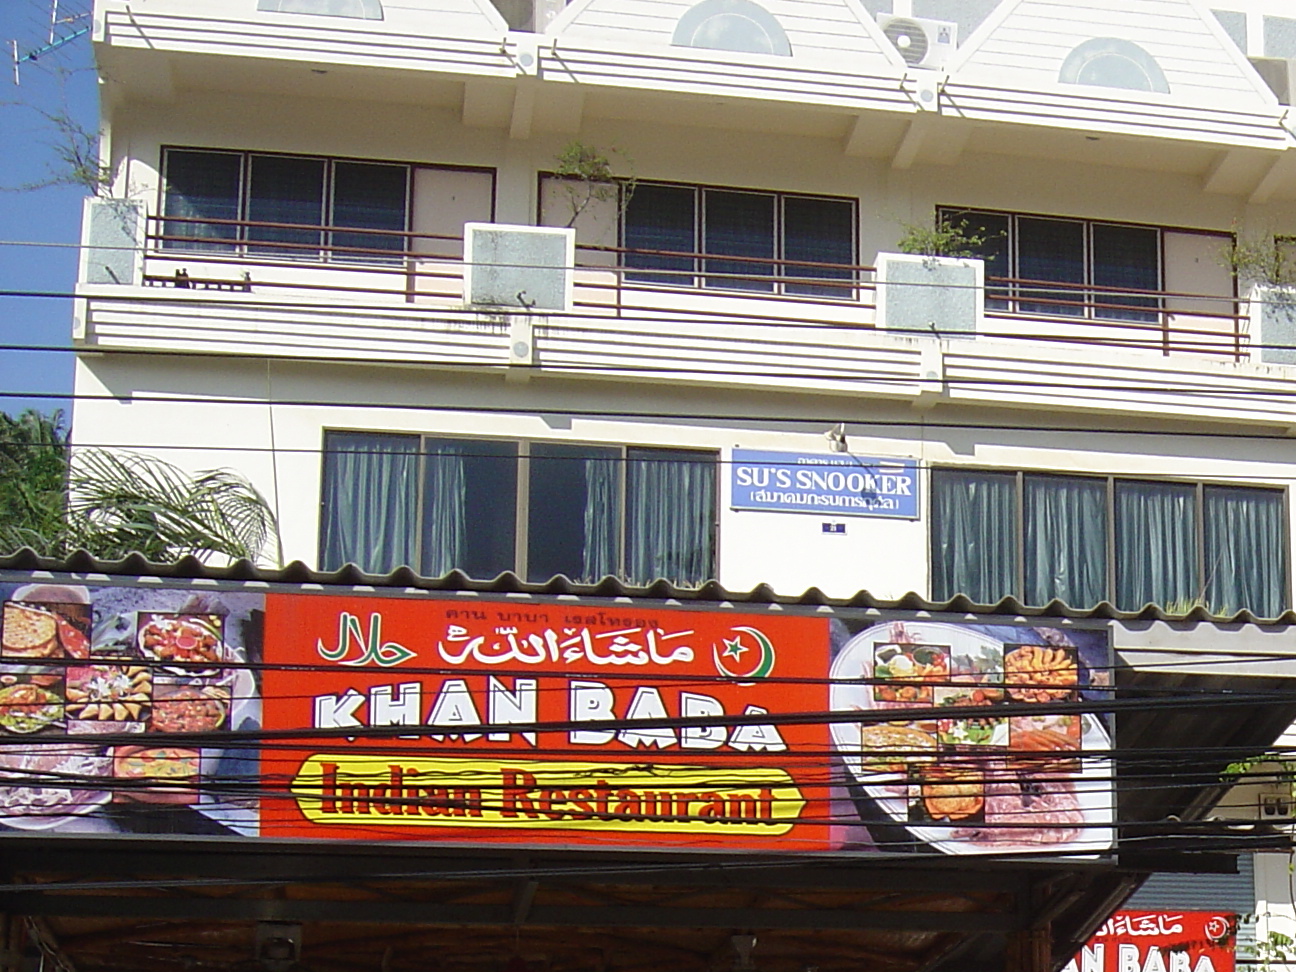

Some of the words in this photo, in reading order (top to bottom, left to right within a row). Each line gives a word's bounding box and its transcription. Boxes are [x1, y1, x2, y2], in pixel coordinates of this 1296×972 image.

[736, 467, 791, 488] SU'S
[796, 470, 912, 496] SNOOKER
[312, 675, 537, 747] KHAN
[568, 680, 788, 753] BABA
[318, 761, 485, 820] Indian
[498, 766, 778, 826] Restaurant
